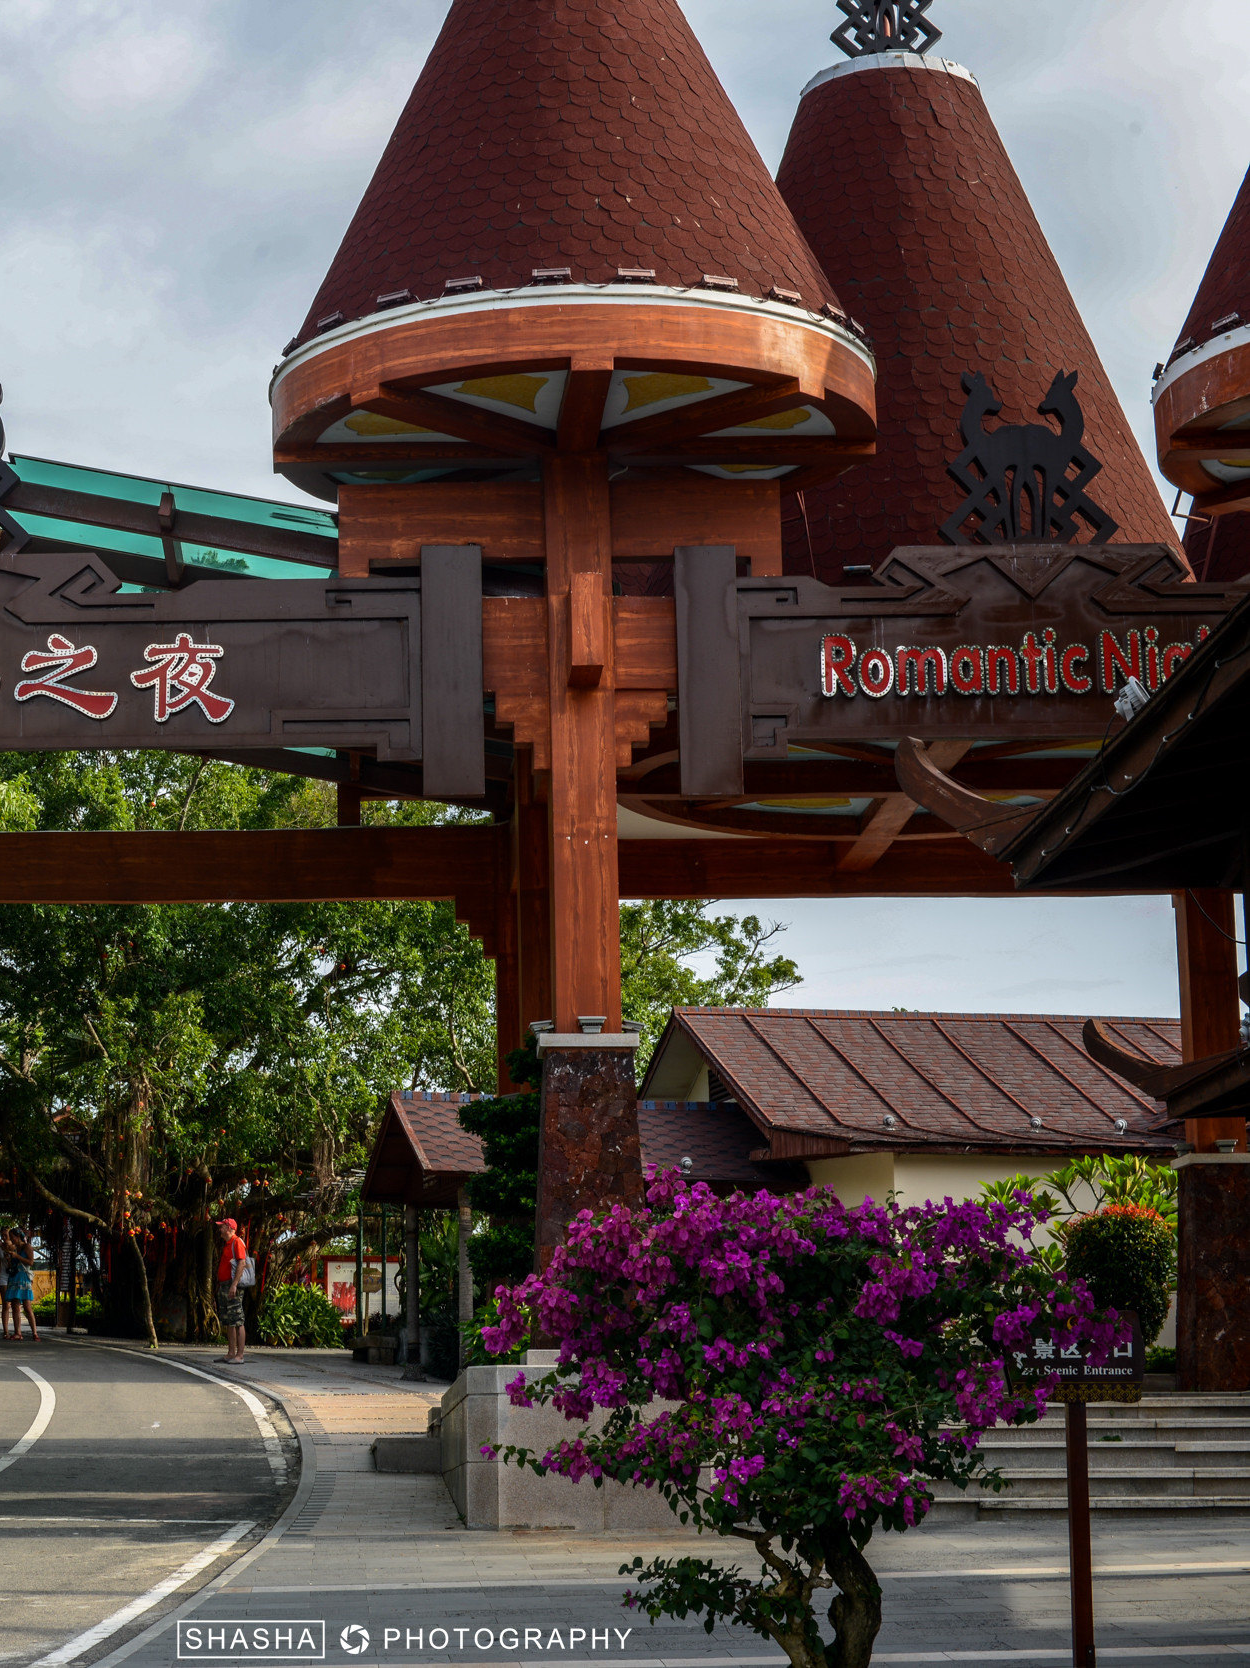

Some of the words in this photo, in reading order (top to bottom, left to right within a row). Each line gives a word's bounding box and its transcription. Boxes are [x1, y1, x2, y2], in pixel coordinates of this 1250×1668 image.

[820, 627, 1093, 698] Romantic
[1032, 1338, 1133, 1359] 景区口
[1043, 1365, 1079, 1376] Scenic
[1083, 1366, 1133, 1375] Entrance
